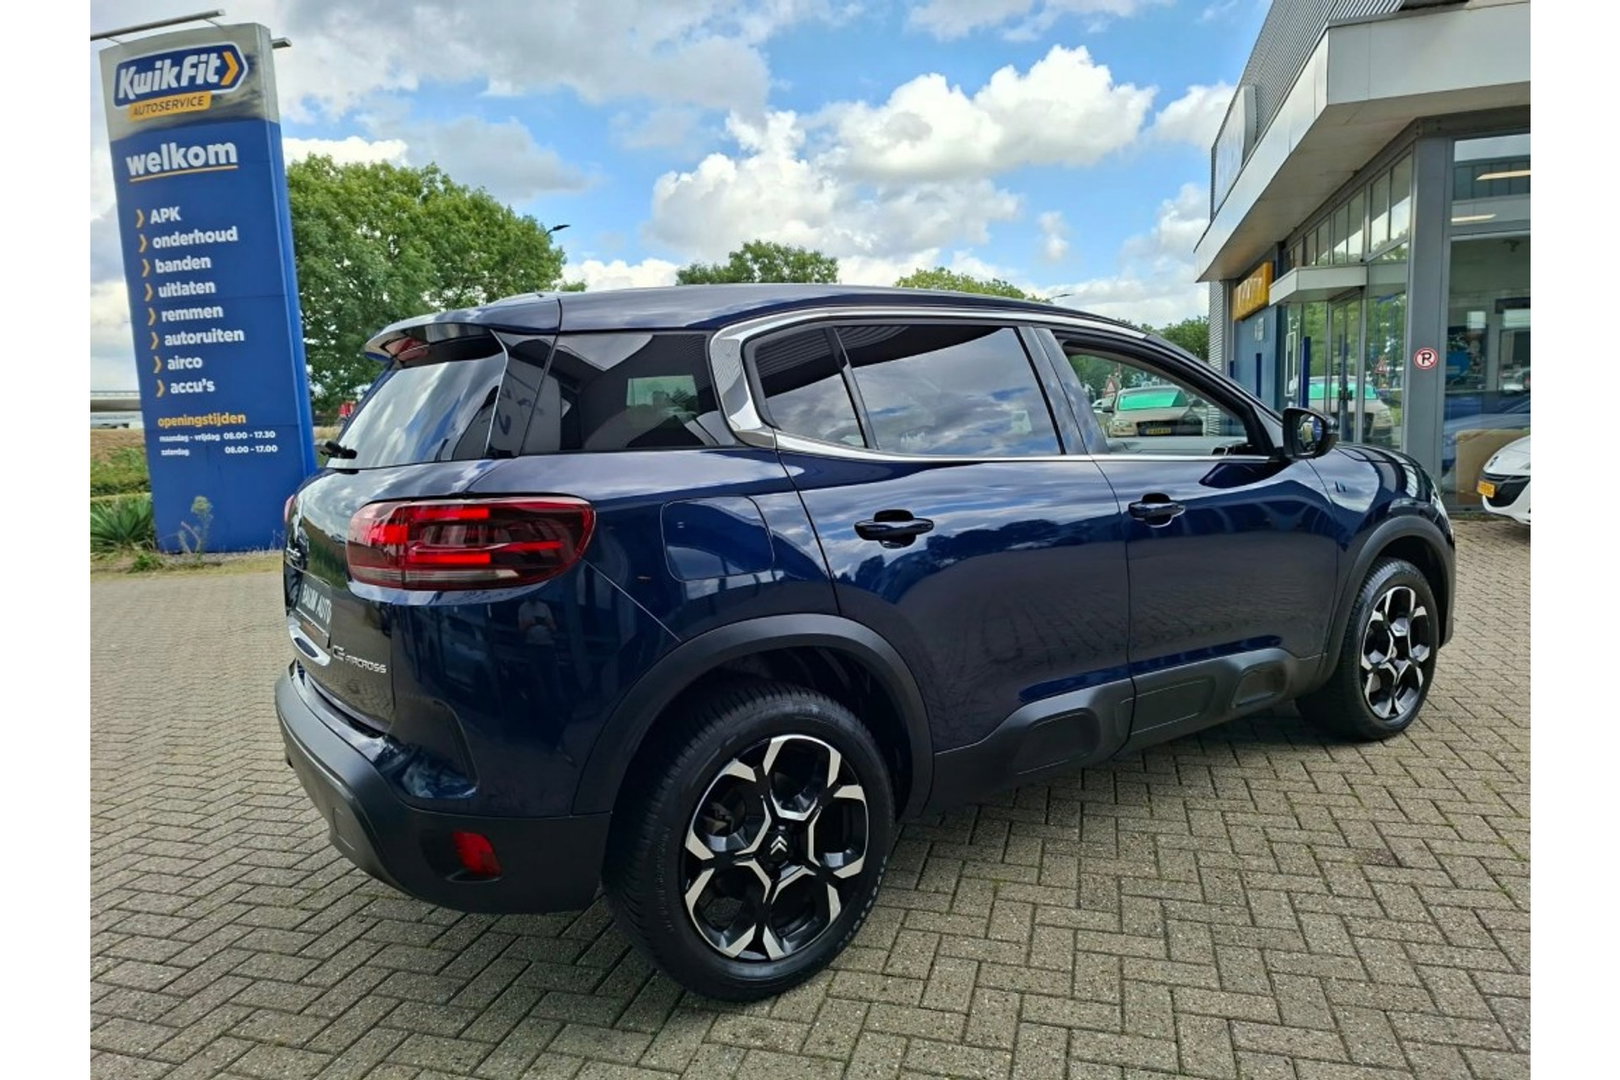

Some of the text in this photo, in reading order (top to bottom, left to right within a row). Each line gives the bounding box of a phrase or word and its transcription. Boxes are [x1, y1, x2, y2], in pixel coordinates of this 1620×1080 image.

[132, 95, 205, 116] AUTOSERVICE
[126, 142, 238, 176] welkom
[150, 206, 182, 224] APK
[152, 226, 239, 249] onderhoud
[155, 255, 212, 274] banden
[158, 281, 216, 298] uitlaten
[161, 305, 224, 322] remmen
[164, 328, 245, 346] autoruiten
[167, 355, 203, 371] airco
[170, 378, 215, 394] accu's
[158, 412, 246, 429] openingstijden
[159, 434, 189, 443] maandag
[194, 432, 220, 442] vrijdag
[223, 431, 248, 440] 08.00
[254, 430, 276, 439] 17.30
[161, 448, 190, 457] zaterdag
[224, 445, 249, 454] 08.00
[255, 444, 278, 453] 17.00
